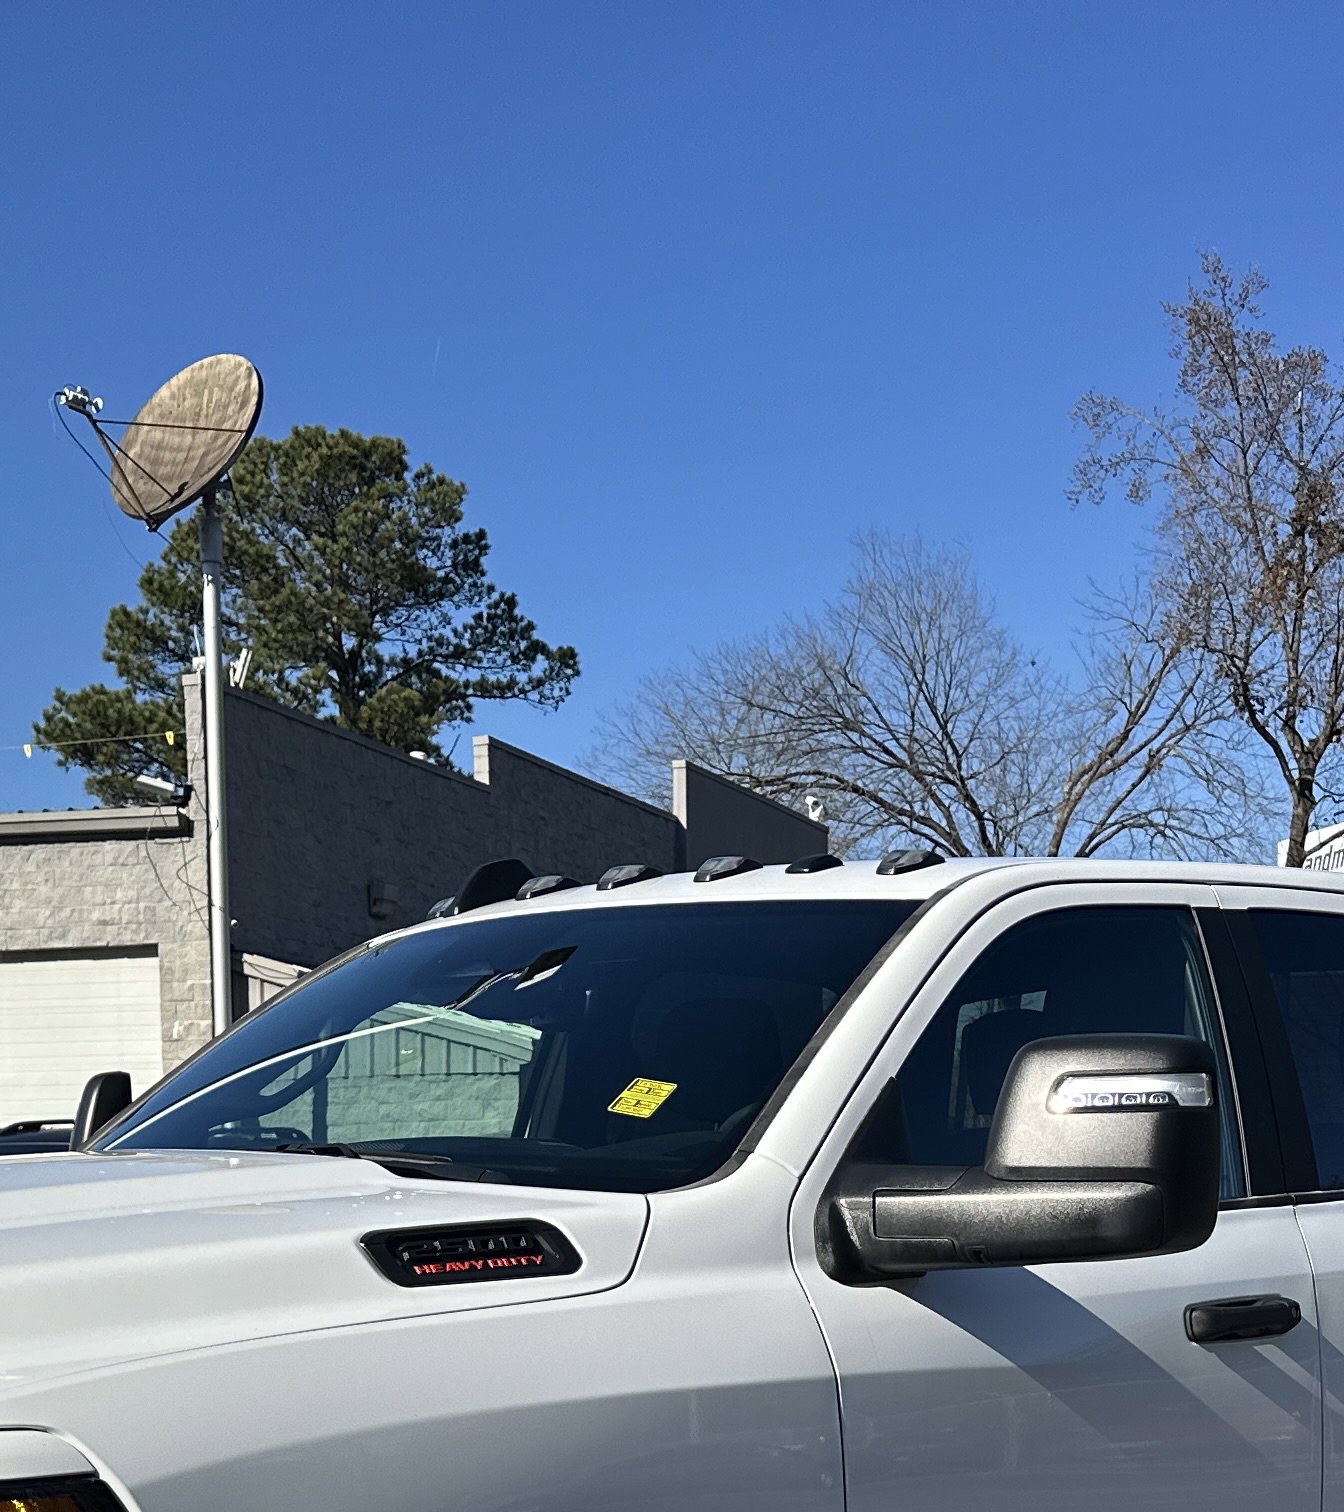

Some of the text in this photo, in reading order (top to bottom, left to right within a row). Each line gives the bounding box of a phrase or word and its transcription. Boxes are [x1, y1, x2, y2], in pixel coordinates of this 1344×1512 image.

[398, 1232, 535, 1263] 2500
[413, 1255, 544, 1275] HEAVY DUTY
